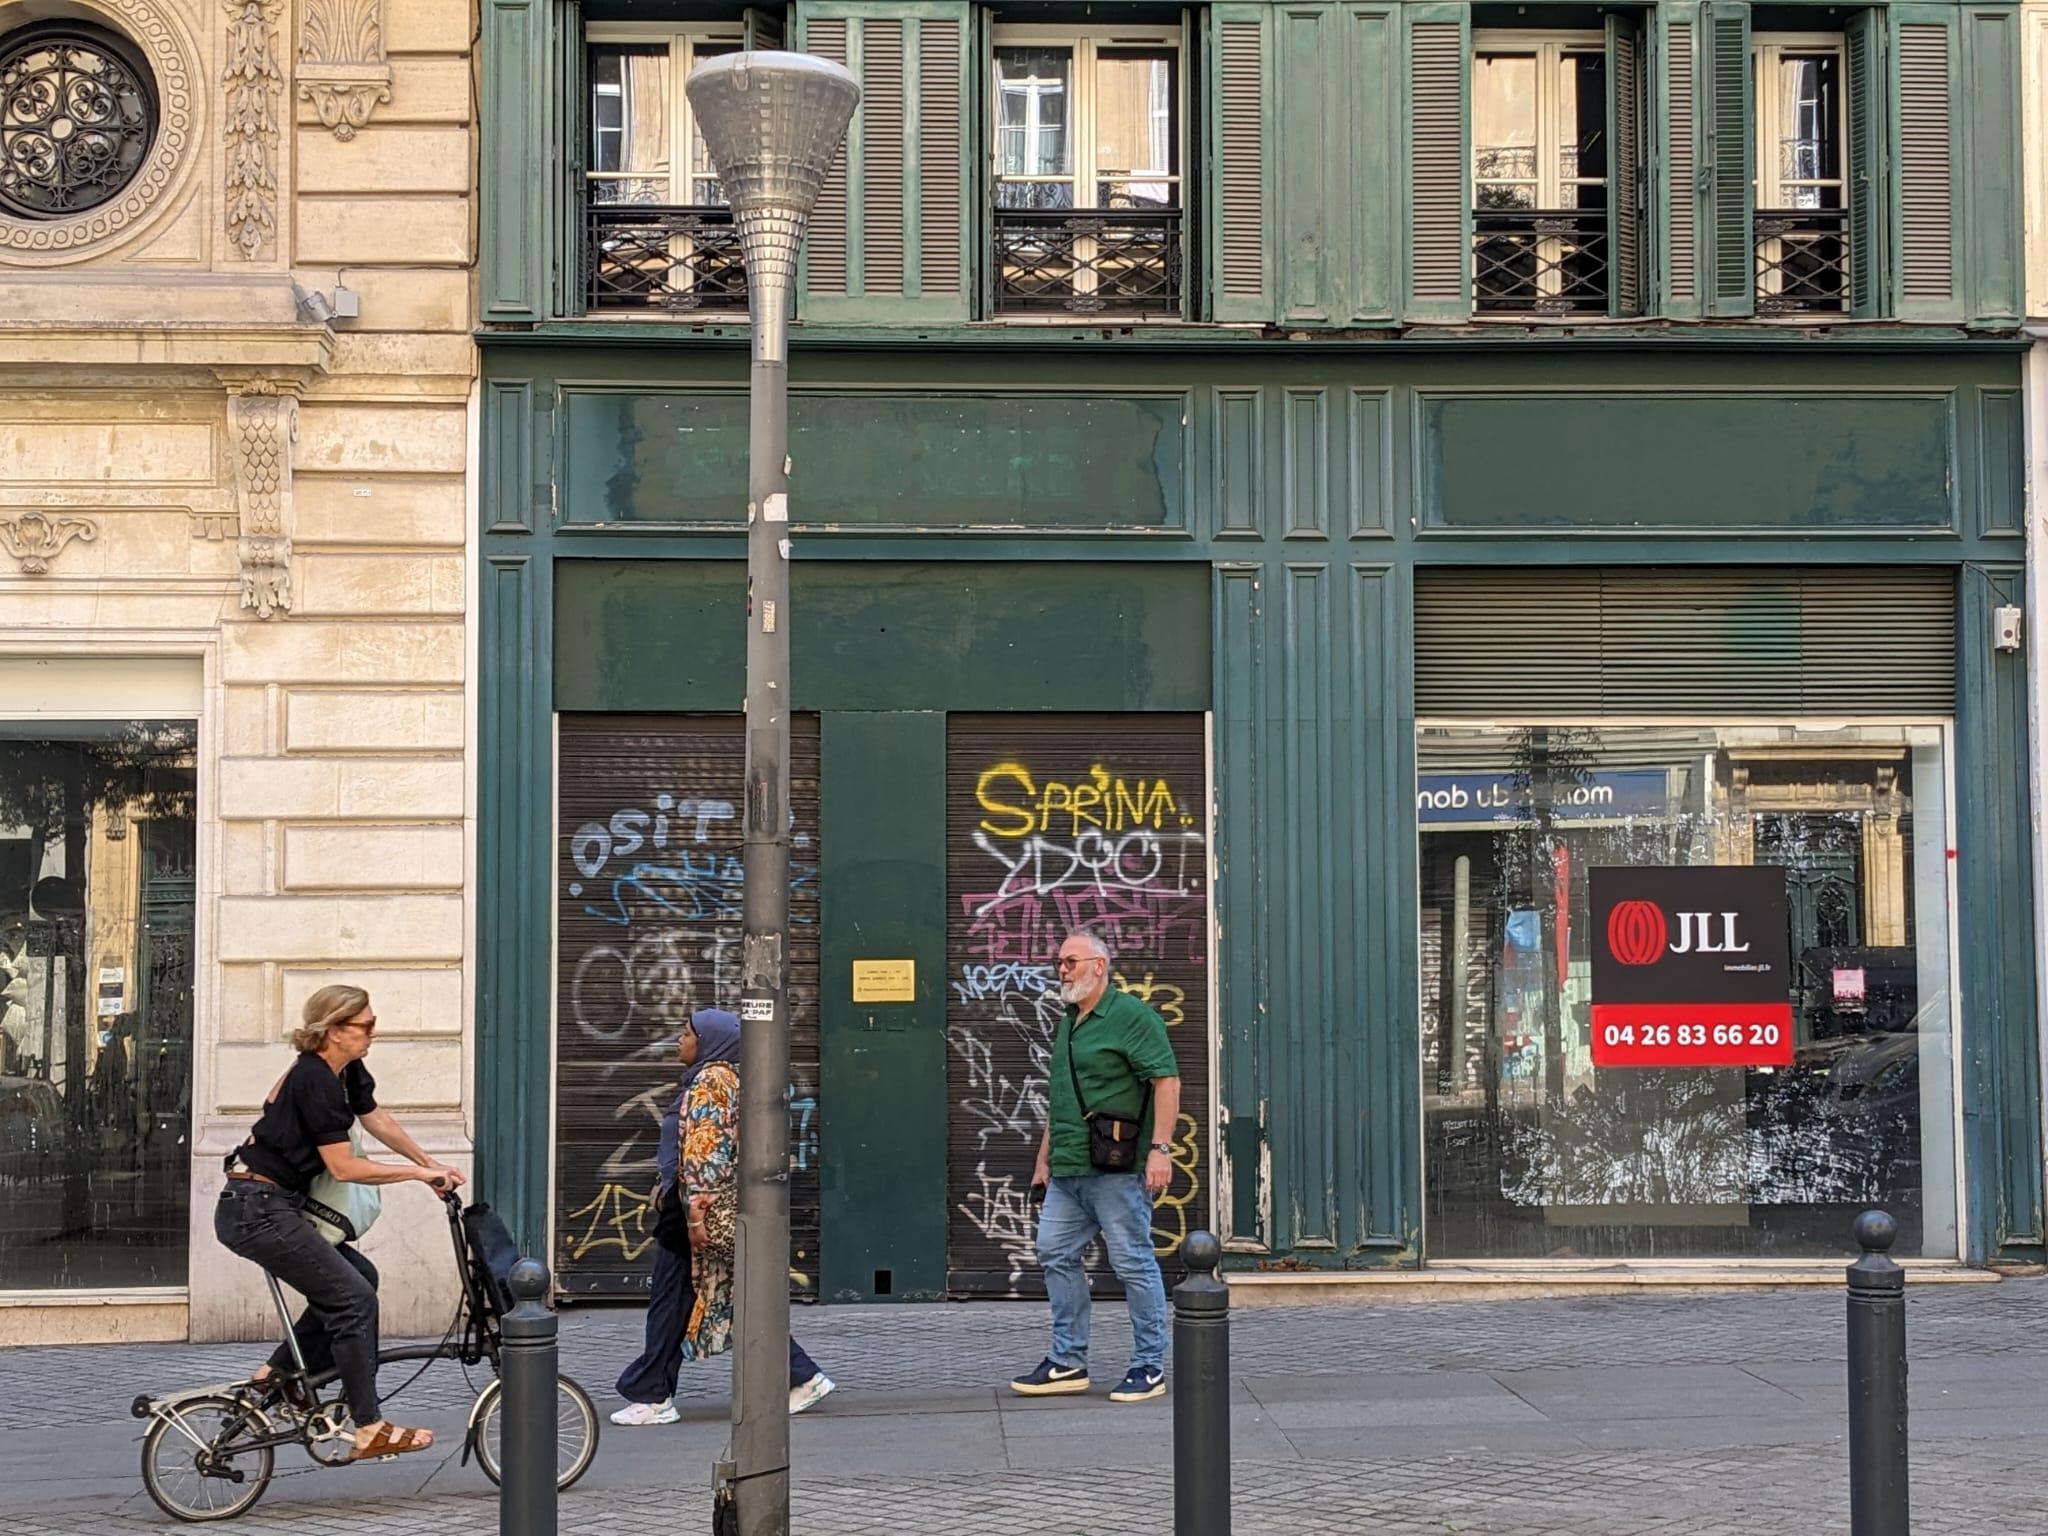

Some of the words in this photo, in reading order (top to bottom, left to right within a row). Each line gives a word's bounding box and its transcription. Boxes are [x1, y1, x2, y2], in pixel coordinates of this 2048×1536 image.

[1669, 912, 1749, 953] JLL
[1604, 1025, 1635, 1045] 04
[1641, 1025, 1671, 1045] 26
[1677, 1025, 1706, 1045] 83
[1713, 1025, 1743, 1045] 66
[1749, 1025, 1779, 1045] 20
